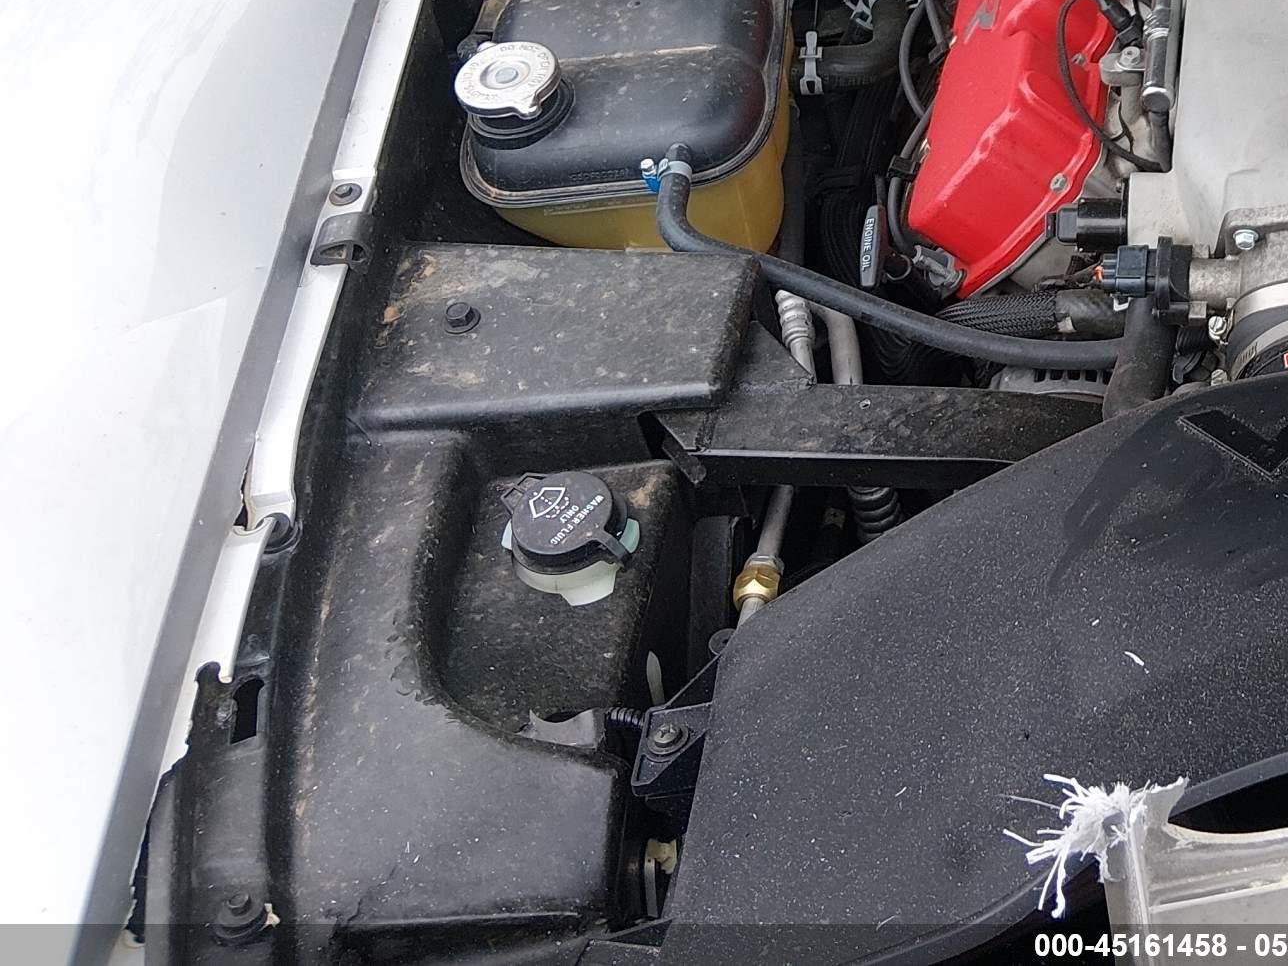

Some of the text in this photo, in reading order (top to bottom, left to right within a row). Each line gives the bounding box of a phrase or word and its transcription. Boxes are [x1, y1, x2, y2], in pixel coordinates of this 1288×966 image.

[861, 217, 875, 272] ENGINE OIL
[549, 494, 604, 545] WASHER FLUID
[558, 505, 580, 524] ONLY
